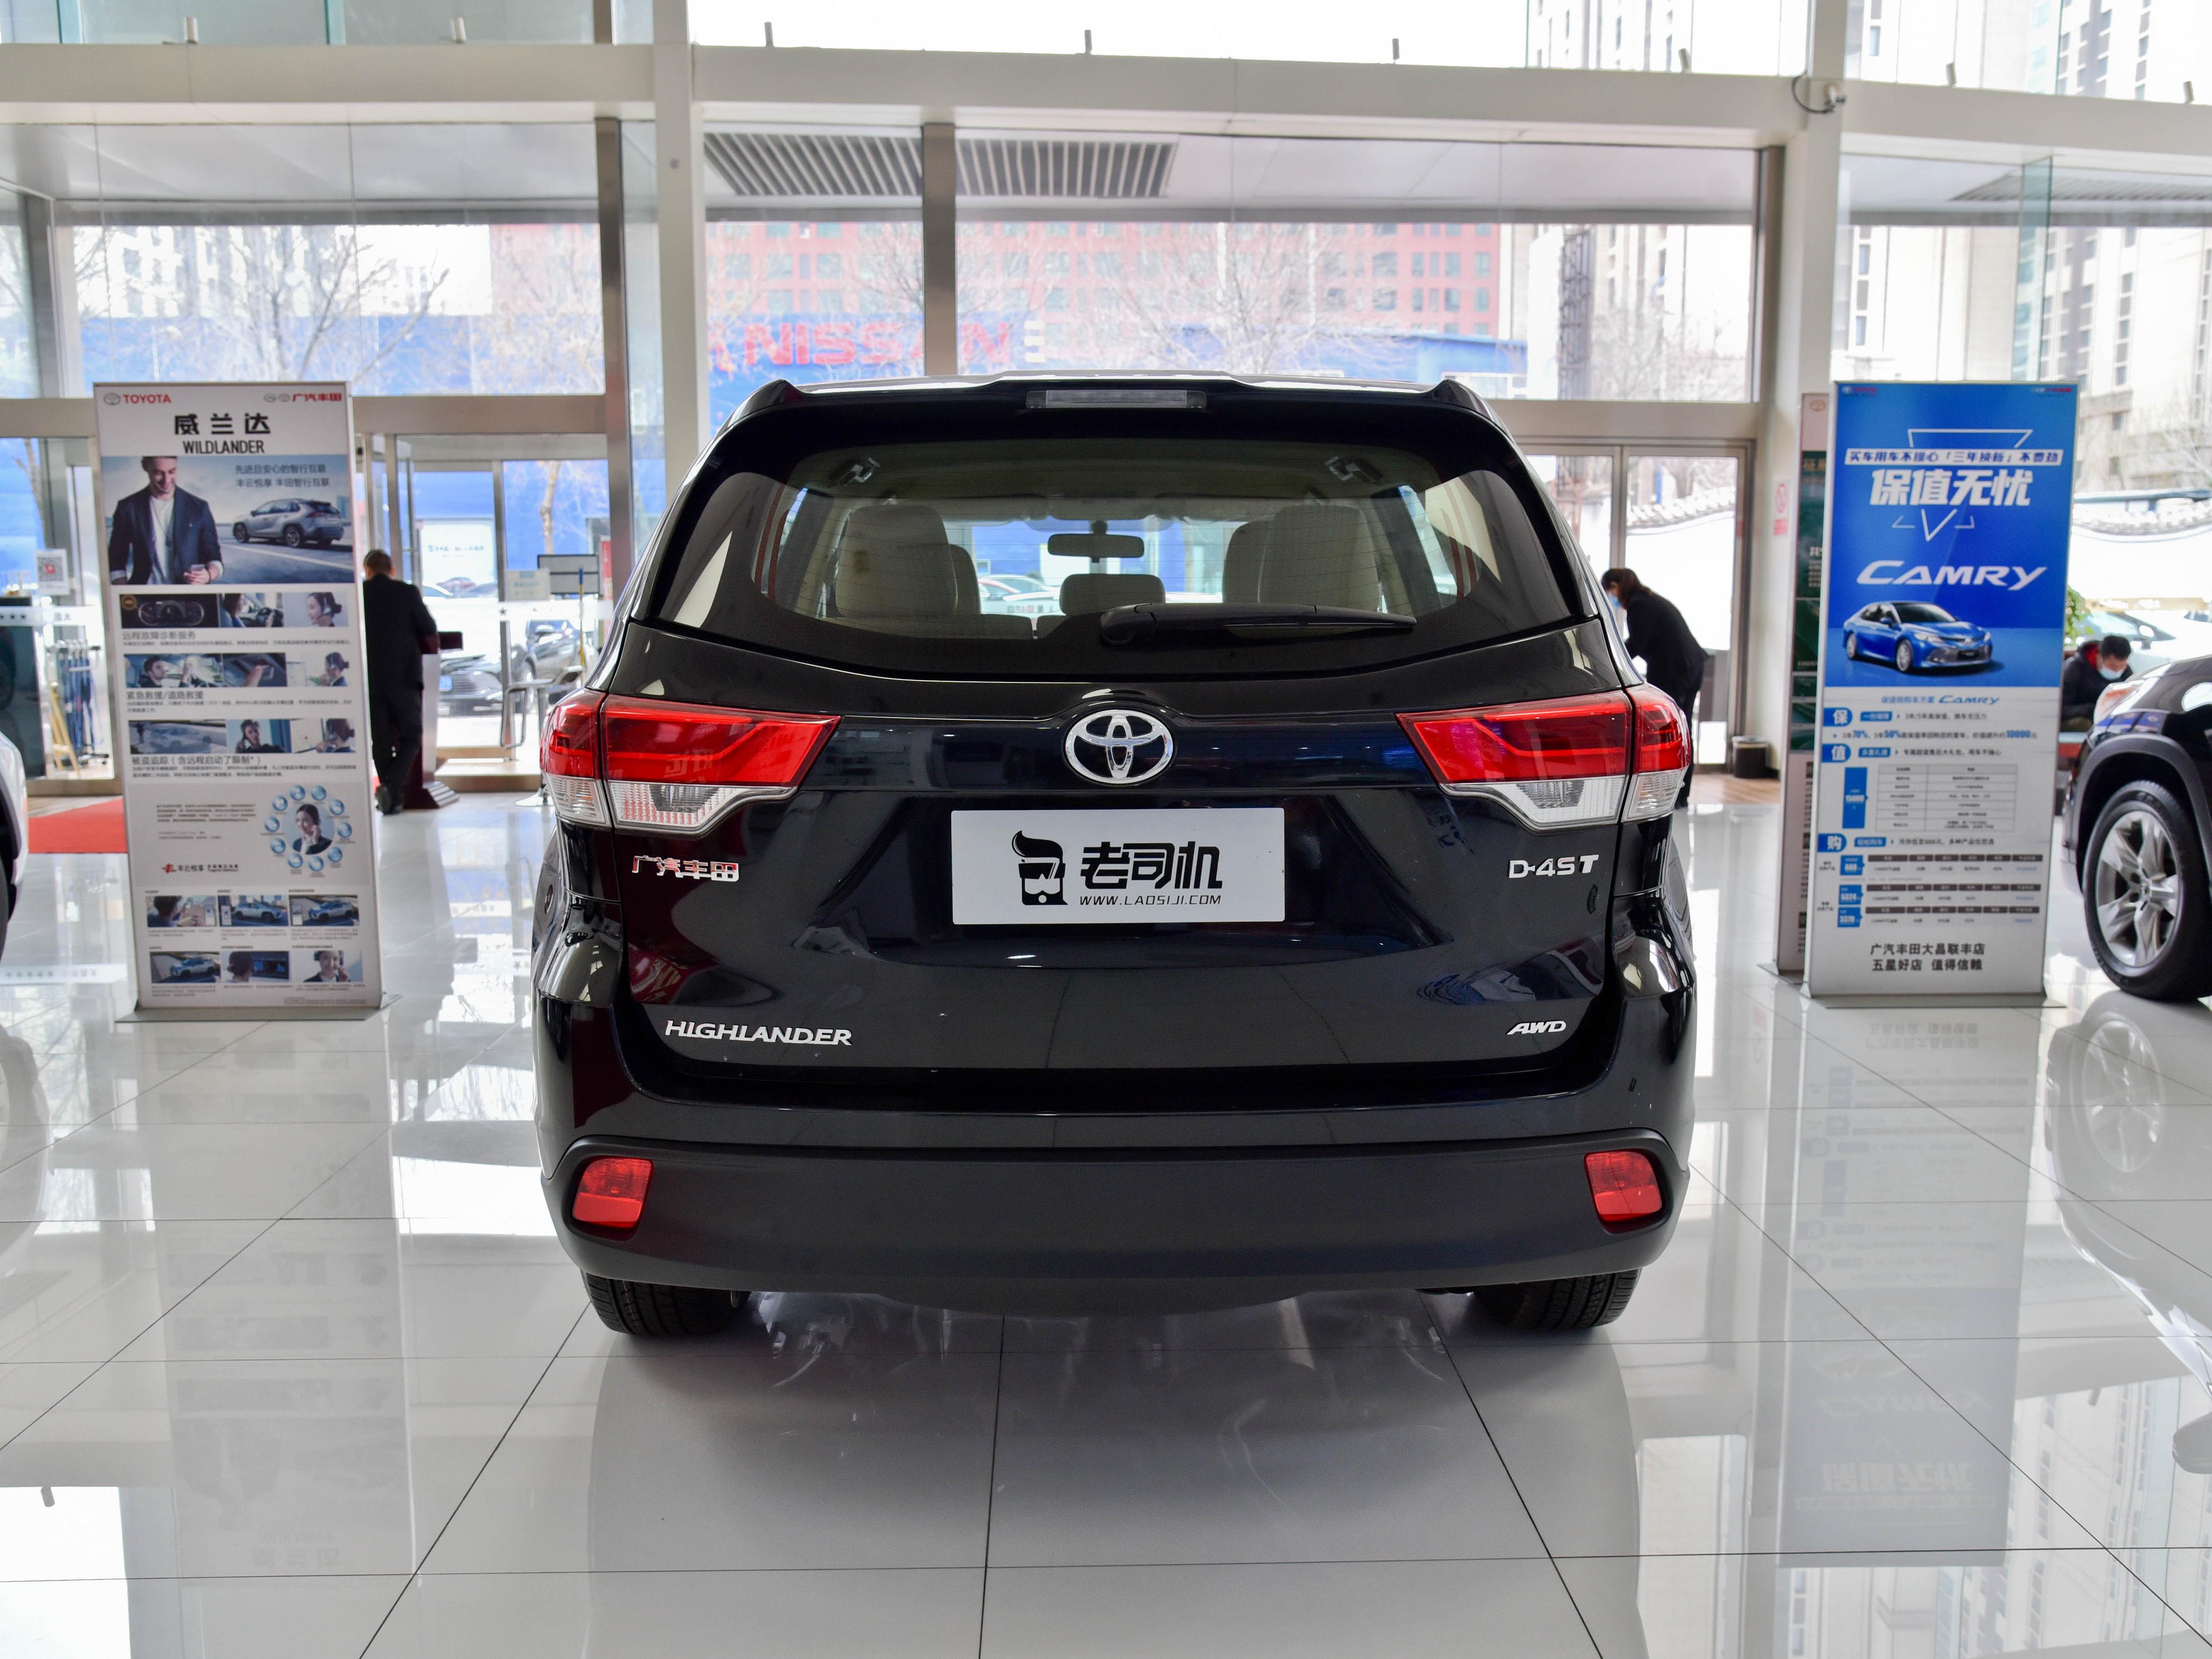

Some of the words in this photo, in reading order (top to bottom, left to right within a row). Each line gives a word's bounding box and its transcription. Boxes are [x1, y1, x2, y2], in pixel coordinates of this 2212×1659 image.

[744, 322, 1010, 365] NISSN
[123, 394, 171, 404] TOYOTA
[292, 393, 342, 402] 广汽丰田
[174, 413, 270, 435] 威兰达
[183, 440, 265, 454] WILDLANDER
[1870, 468, 2034, 506] 保值无忧
[1857, 560, 2048, 591] CAMRY
[1939, 695, 2001, 704] CAMRY
[1832, 709, 1849, 725] 保
[1831, 746, 1847, 762] 值
[1827, 835, 1842, 851] 购
[632, 855, 740, 882] 广汽丰田
[1080, 841, 1223, 889] 老司机
[1080, 895, 1222, 905] WWW.LAOSIJI.COM
[1870, 943, 1985, 955] 广汽丰田大昌联丰店
[1872, 959, 1922, 971] 五星好店
[1931, 959, 1983, 971] 值得信赖
[665, 1020, 853, 1046] HIGHLANDER
[1507, 1021, 1566, 1035] AWD
